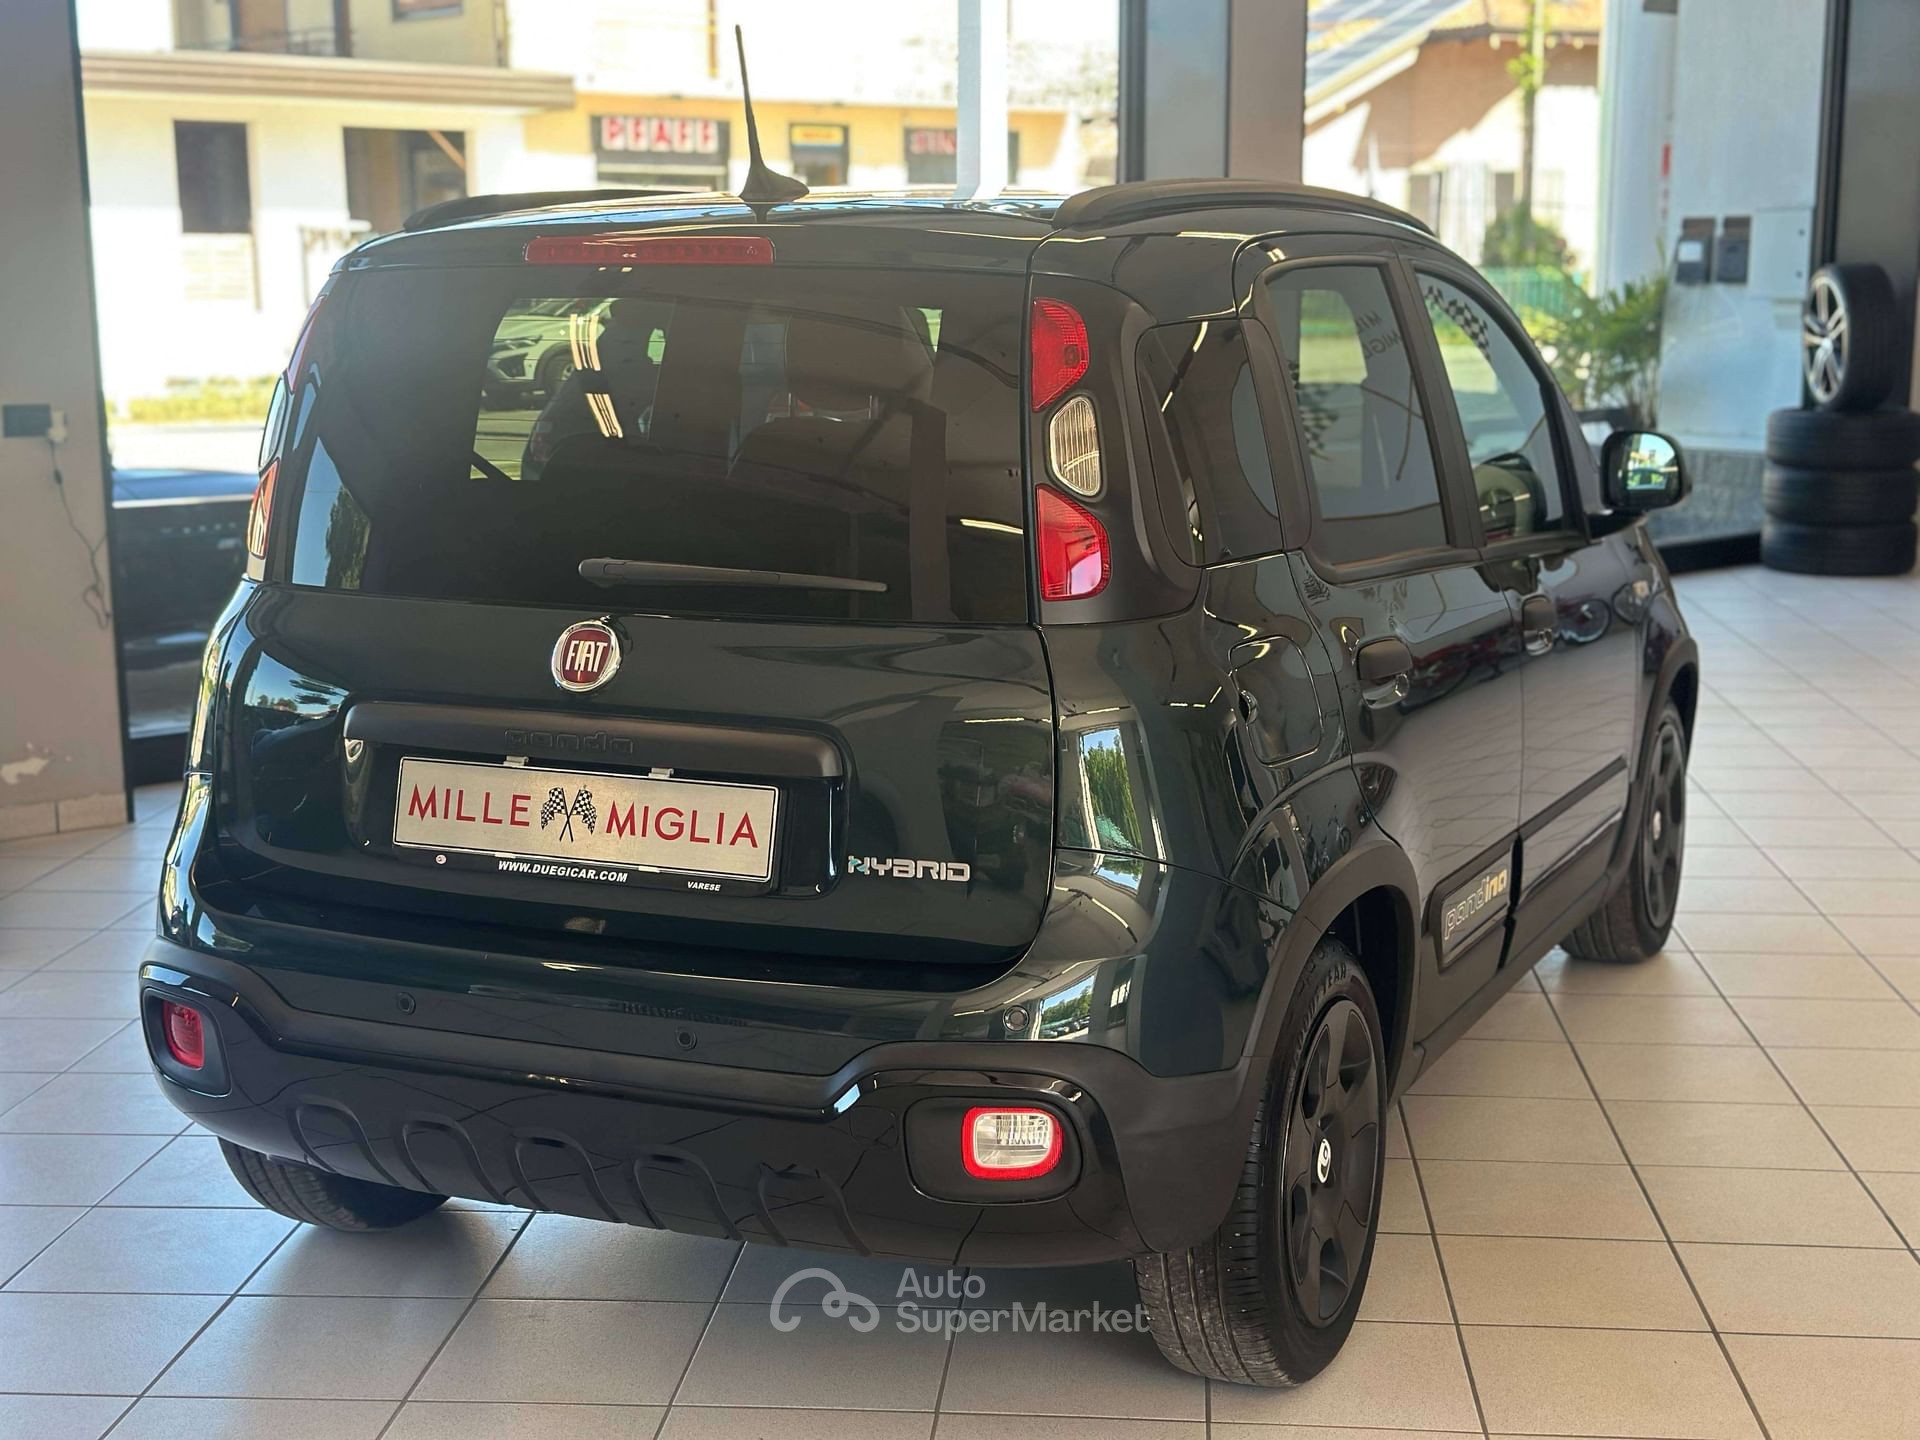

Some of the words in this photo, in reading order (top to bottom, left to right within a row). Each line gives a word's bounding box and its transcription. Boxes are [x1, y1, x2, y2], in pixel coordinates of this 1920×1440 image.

[565, 640, 608, 672] FIAT
[504, 729, 635, 755] panda
[407, 784, 532, 827] MILLE
[605, 801, 759, 848] MIGLIA
[498, 860, 628, 883] WWW.DUEGICAR.COM
[847, 855, 971, 881] HYBRID
[687, 880, 721, 892] VARESE
[1445, 869, 1507, 940] pandino
